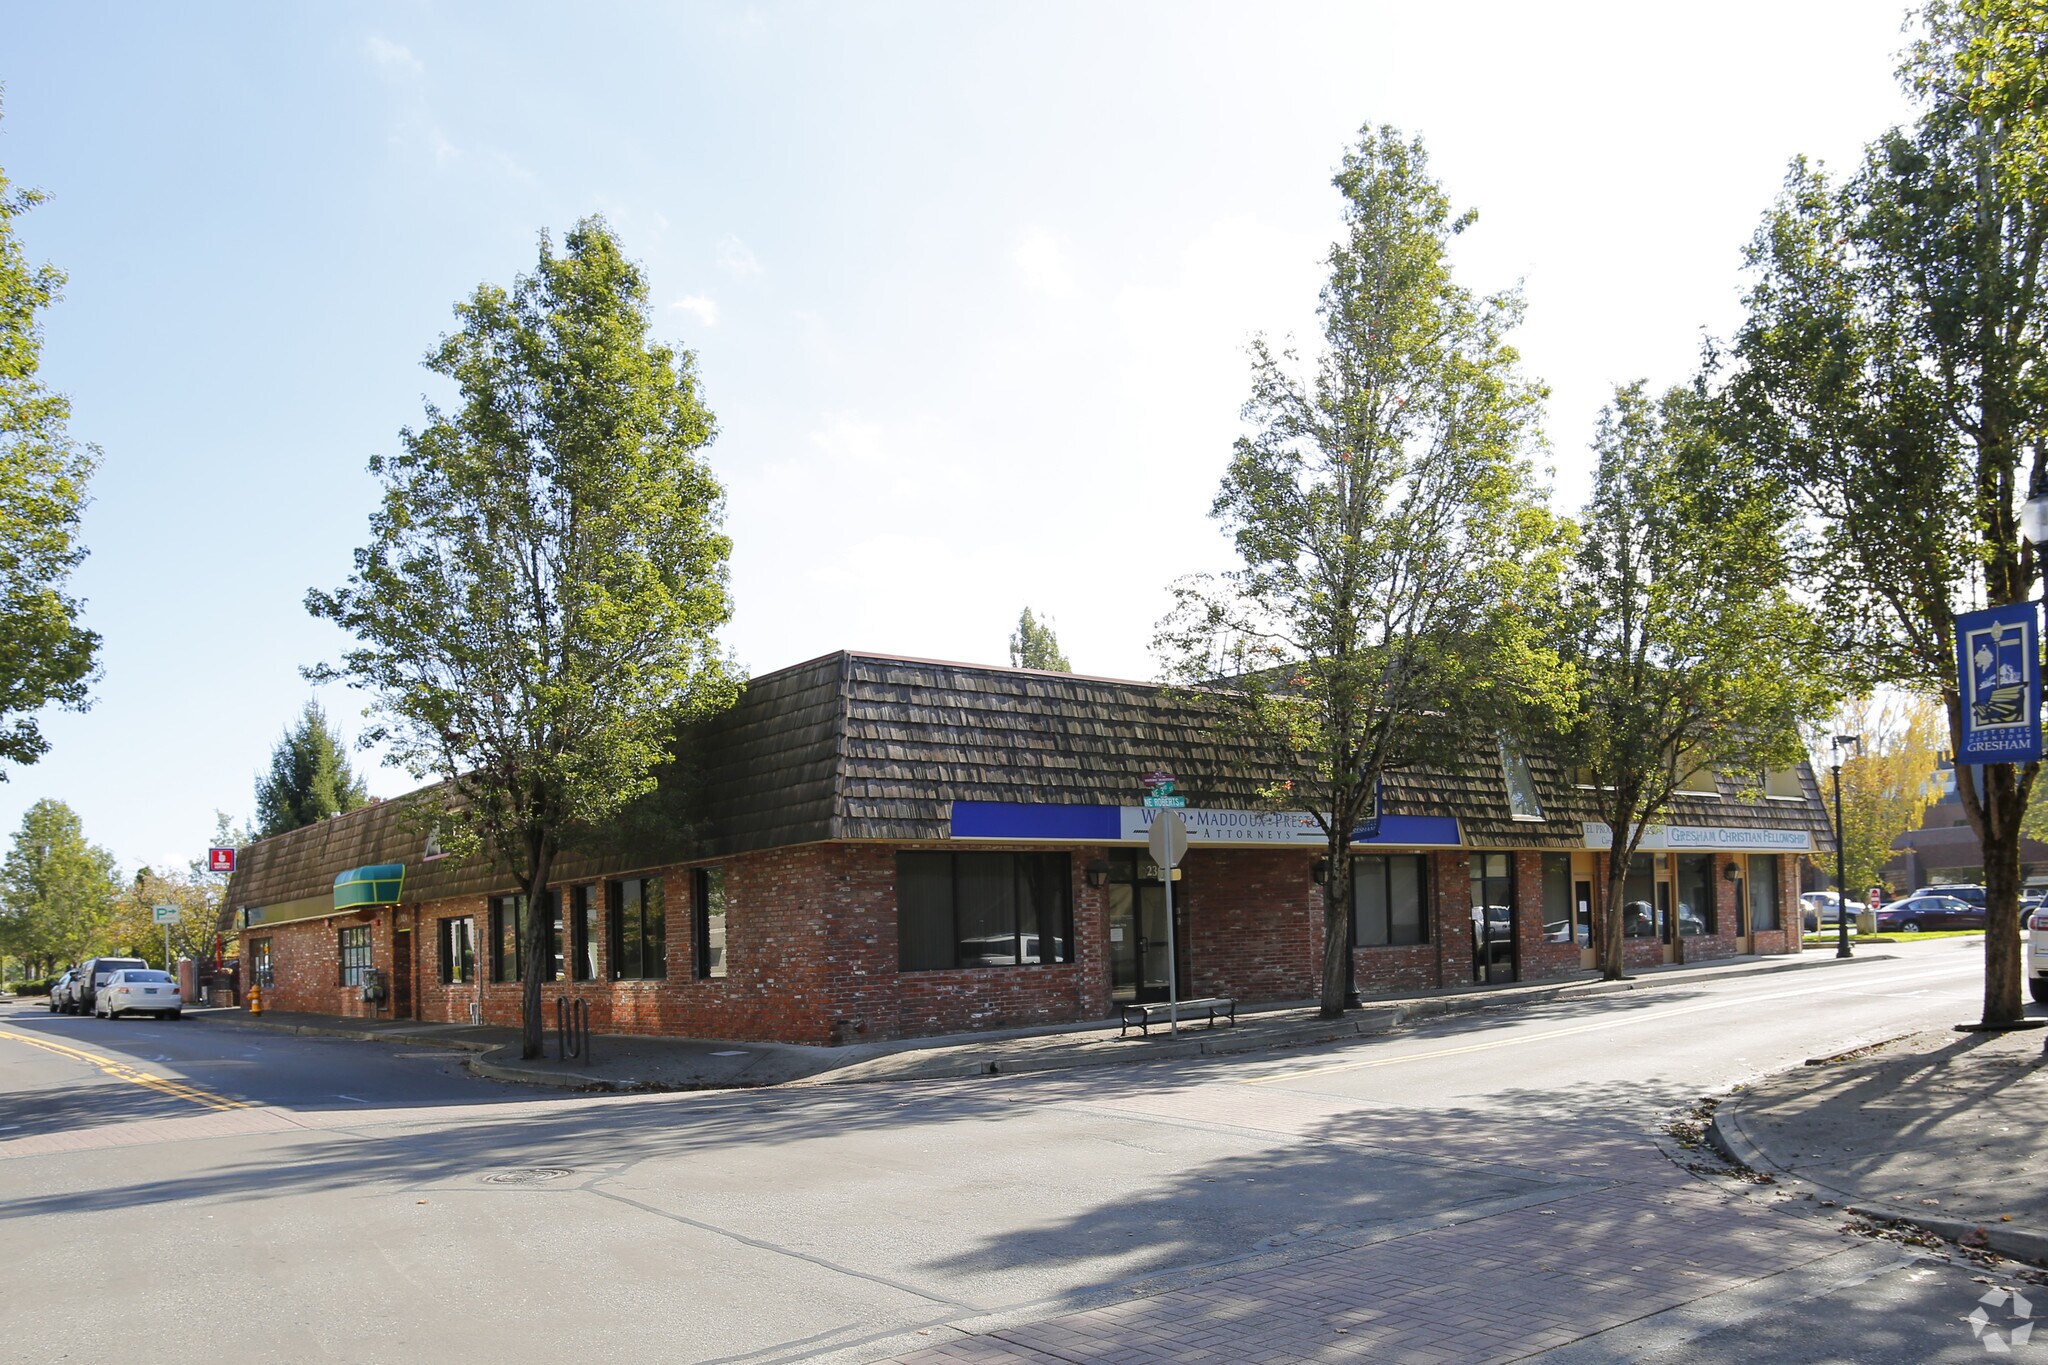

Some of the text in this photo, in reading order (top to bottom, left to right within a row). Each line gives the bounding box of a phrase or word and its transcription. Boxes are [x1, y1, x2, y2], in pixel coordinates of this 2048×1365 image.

[1969, 726, 2030, 737] HISTORIC
[1969, 732, 2031, 743] DOWNTOWN
[1967, 739, 2031, 752] GRESHAM
[1144, 798, 1153, 807] NE
[1154, 797, 1180, 807] ROBERTS
[1197, 811, 1266, 827] MADDOUX
[1275, 813, 1329, 829] PRESTO
[1203, 829, 1291, 840] ATTORNEYS
[1671, 828, 1716, 842] GRESHAM
[1718, 829, 1761, 843] CHRISTIAN
[1763, 831, 1806, 844] FELLOWSHIP
[156, 908, 168, 920] P
